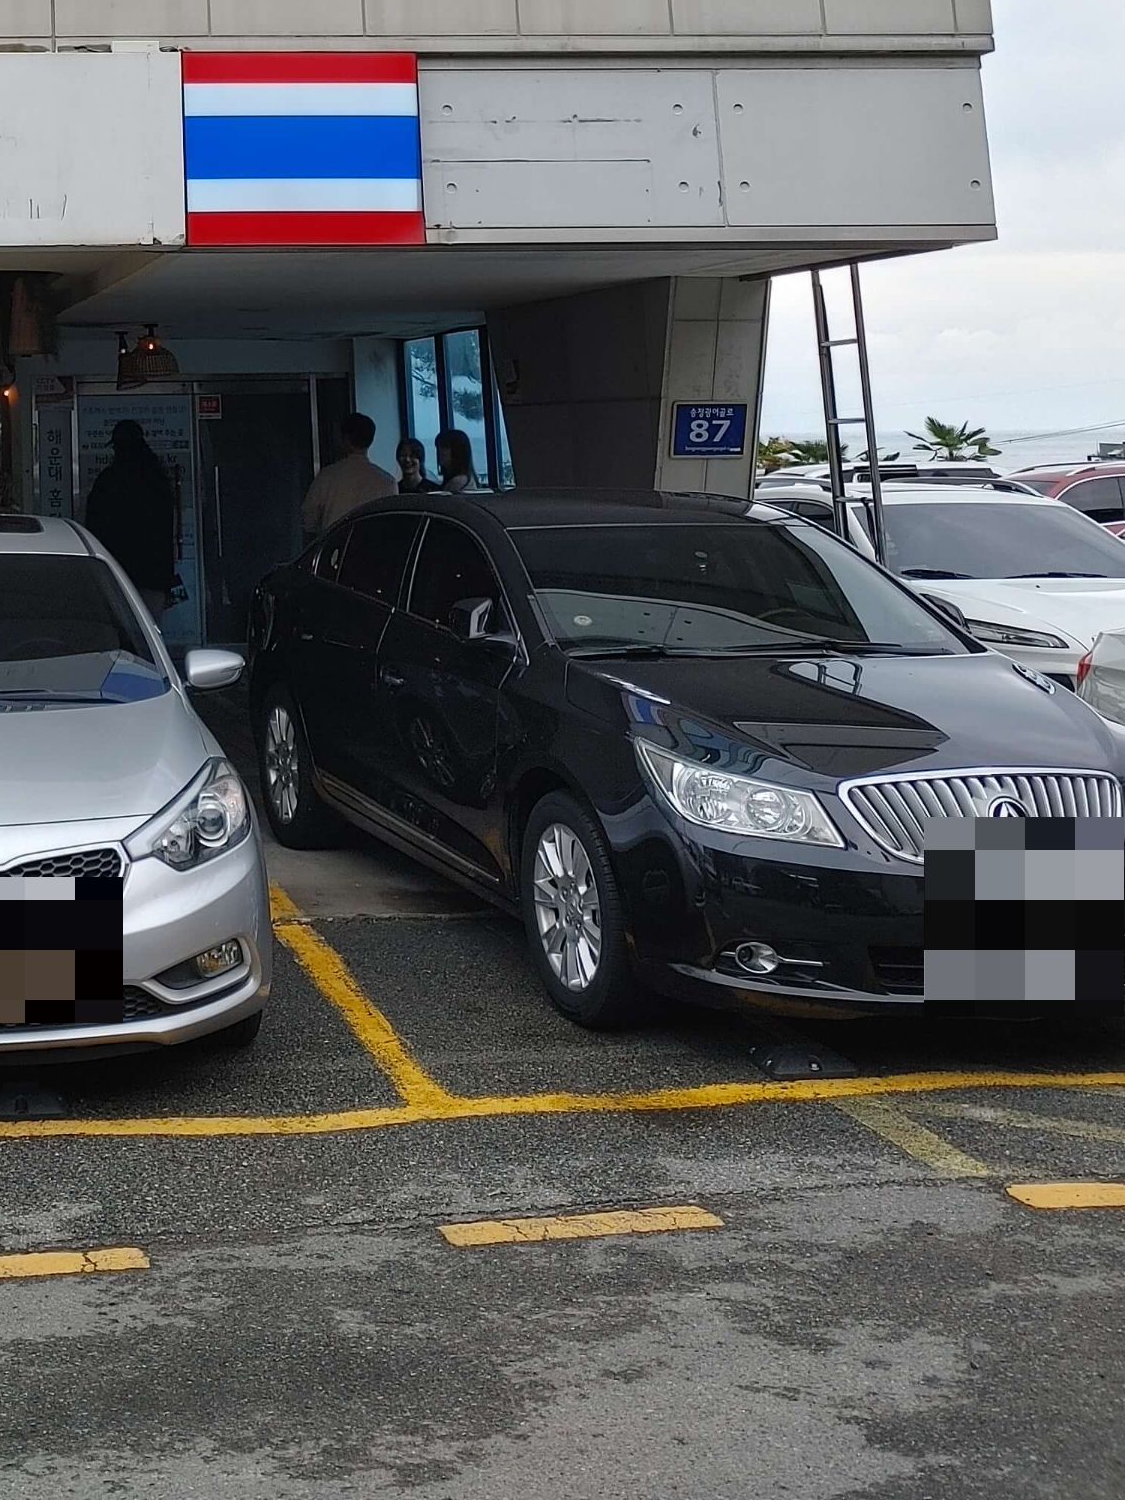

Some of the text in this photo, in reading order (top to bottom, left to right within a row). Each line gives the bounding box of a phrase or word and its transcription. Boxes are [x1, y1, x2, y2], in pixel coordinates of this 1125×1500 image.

[690, 407, 734, 418] 송정광어골로
[689, 419, 731, 443] 87
[47, 429, 62, 481] 해운대
